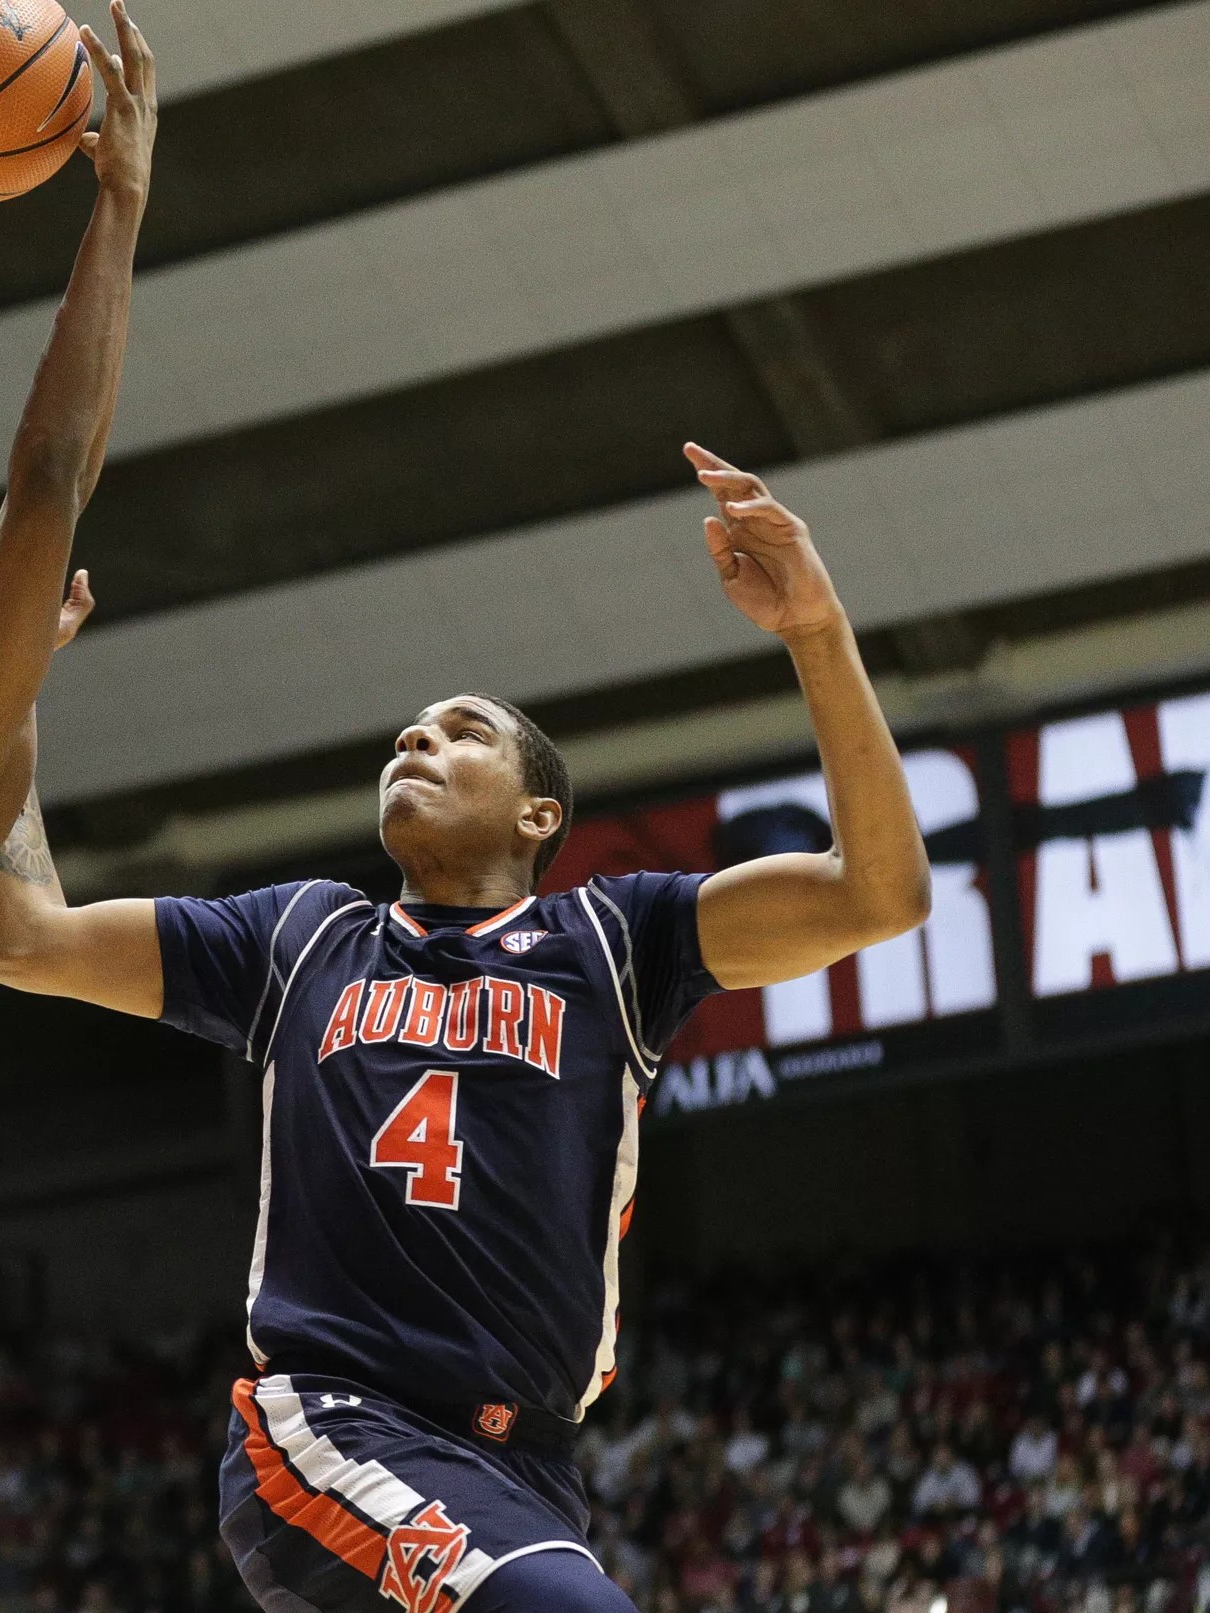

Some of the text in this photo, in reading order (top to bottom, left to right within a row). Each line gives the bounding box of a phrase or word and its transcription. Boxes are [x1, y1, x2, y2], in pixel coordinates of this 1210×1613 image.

[501, 930, 548, 954] SEC
[318, 974, 566, 1080] AUBURN
[369, 1069, 464, 1211] 4
